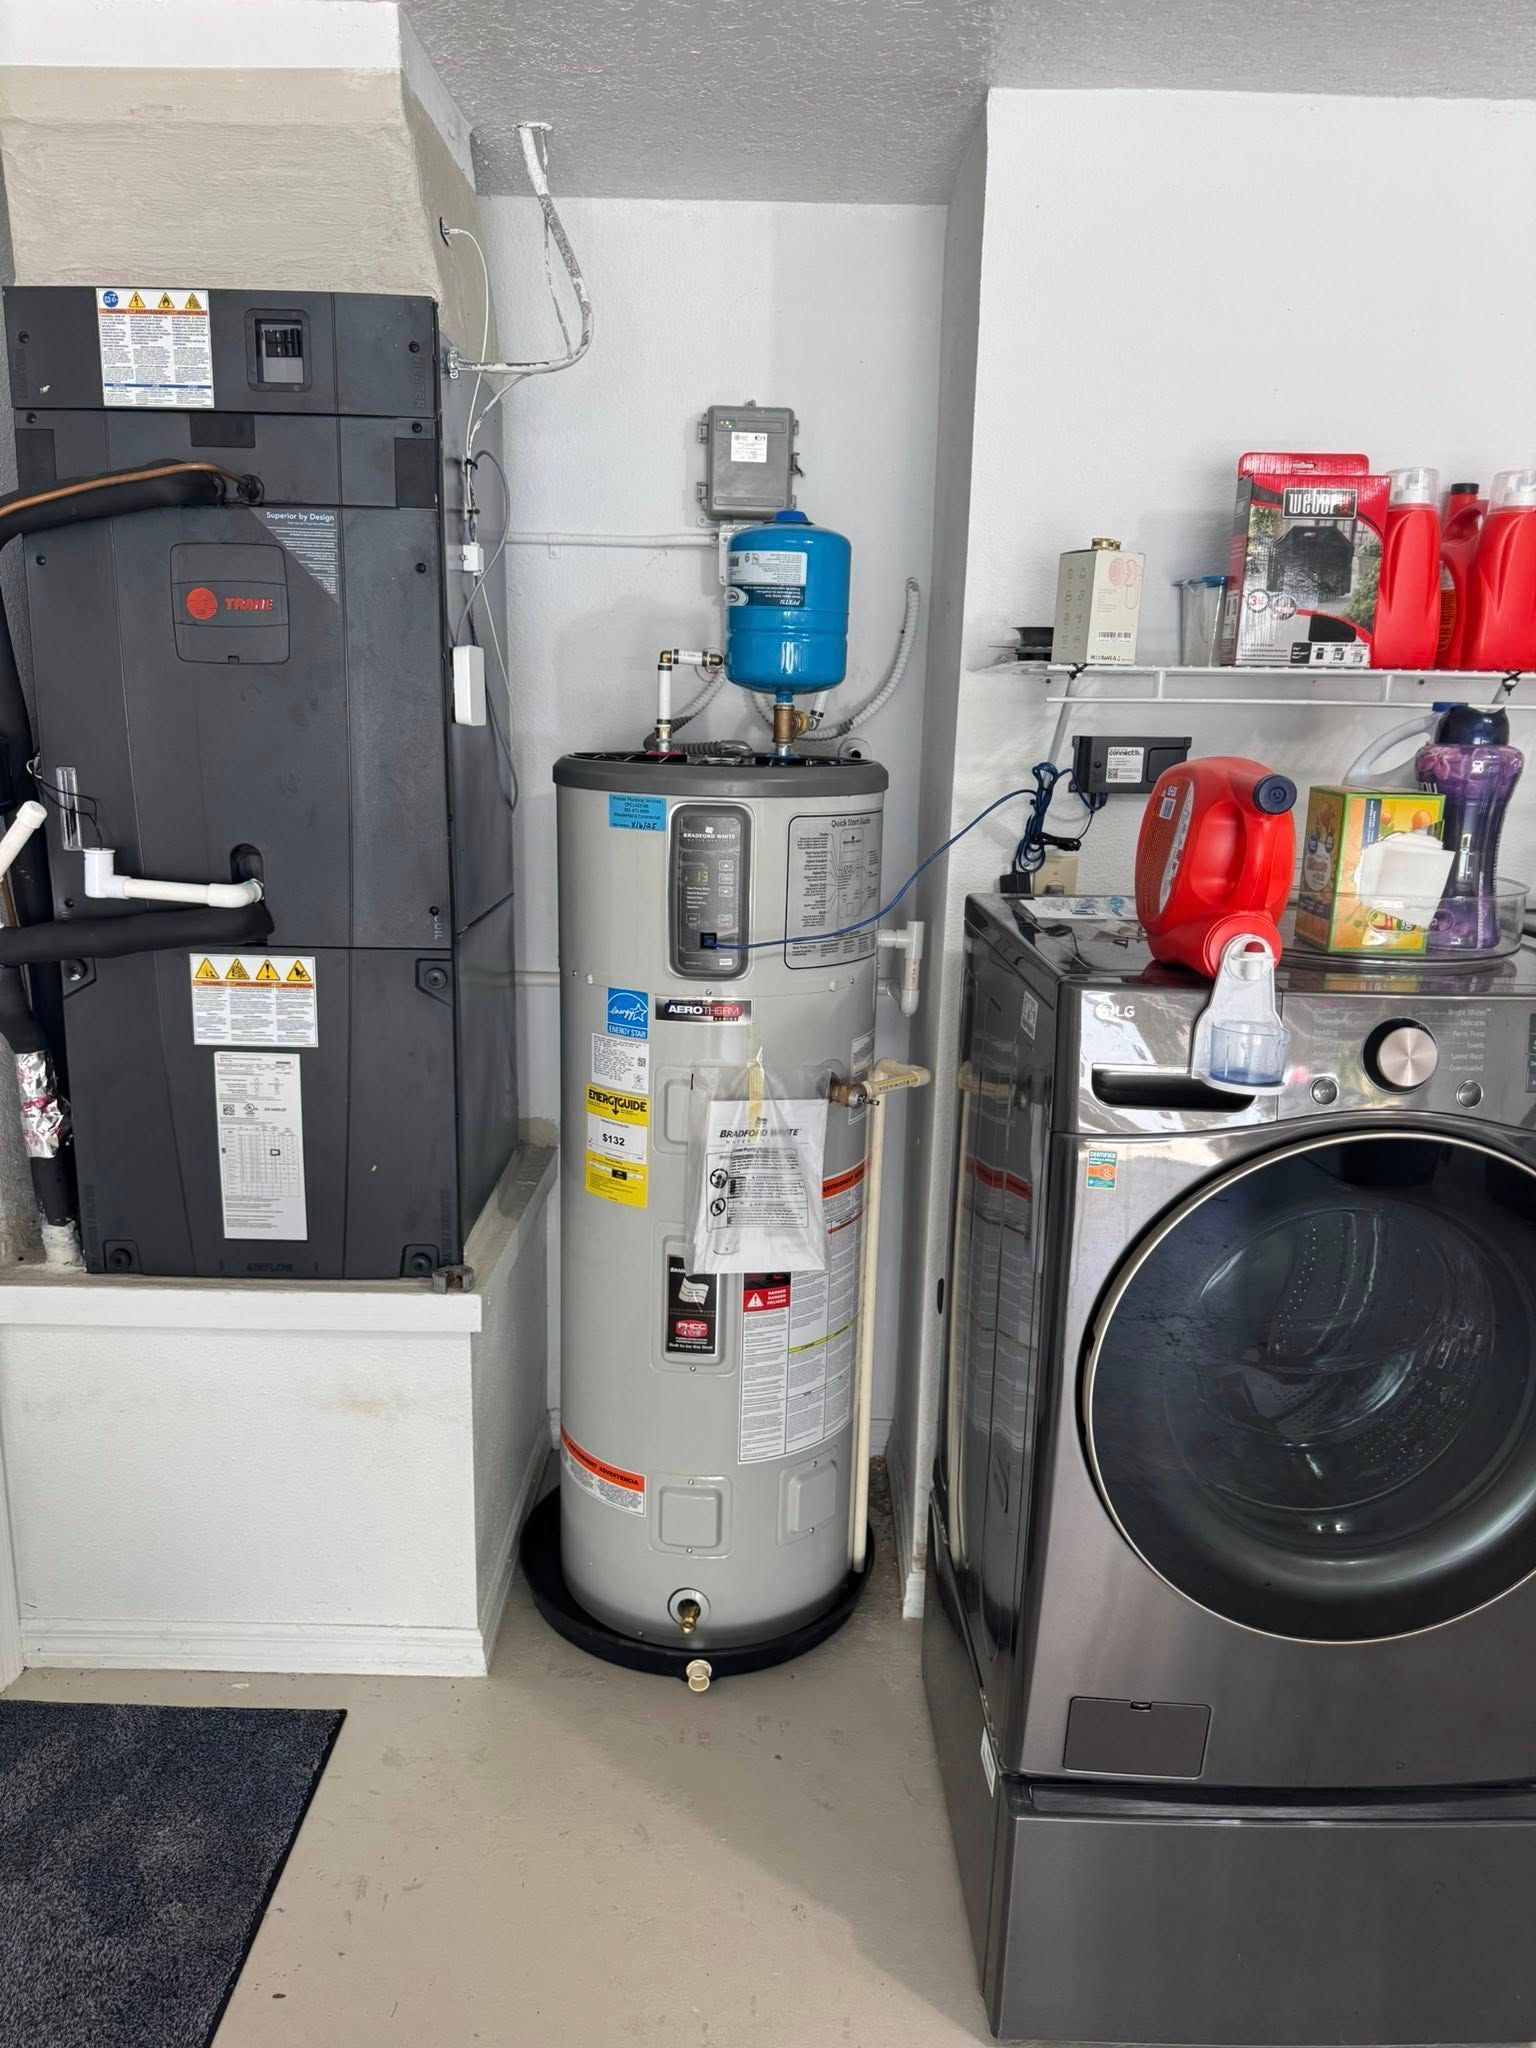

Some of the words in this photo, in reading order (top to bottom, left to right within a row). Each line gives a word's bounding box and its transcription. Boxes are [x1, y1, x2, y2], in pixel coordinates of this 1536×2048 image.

[1289, 490, 1342, 515] weber
[266, 511, 297, 520] Superior
[298, 513, 308, 521] by
[309, 513, 334, 522] Design
[225, 597, 273, 611] TRANE
[668, 1004, 740, 1016] AEROTHERM
[1115, 1005, 1135, 1018] LG
[608, 1024, 630, 1036] ENERGY
[630, 1028, 647, 1039] STAR
[602, 1133, 625, 1147] $132
